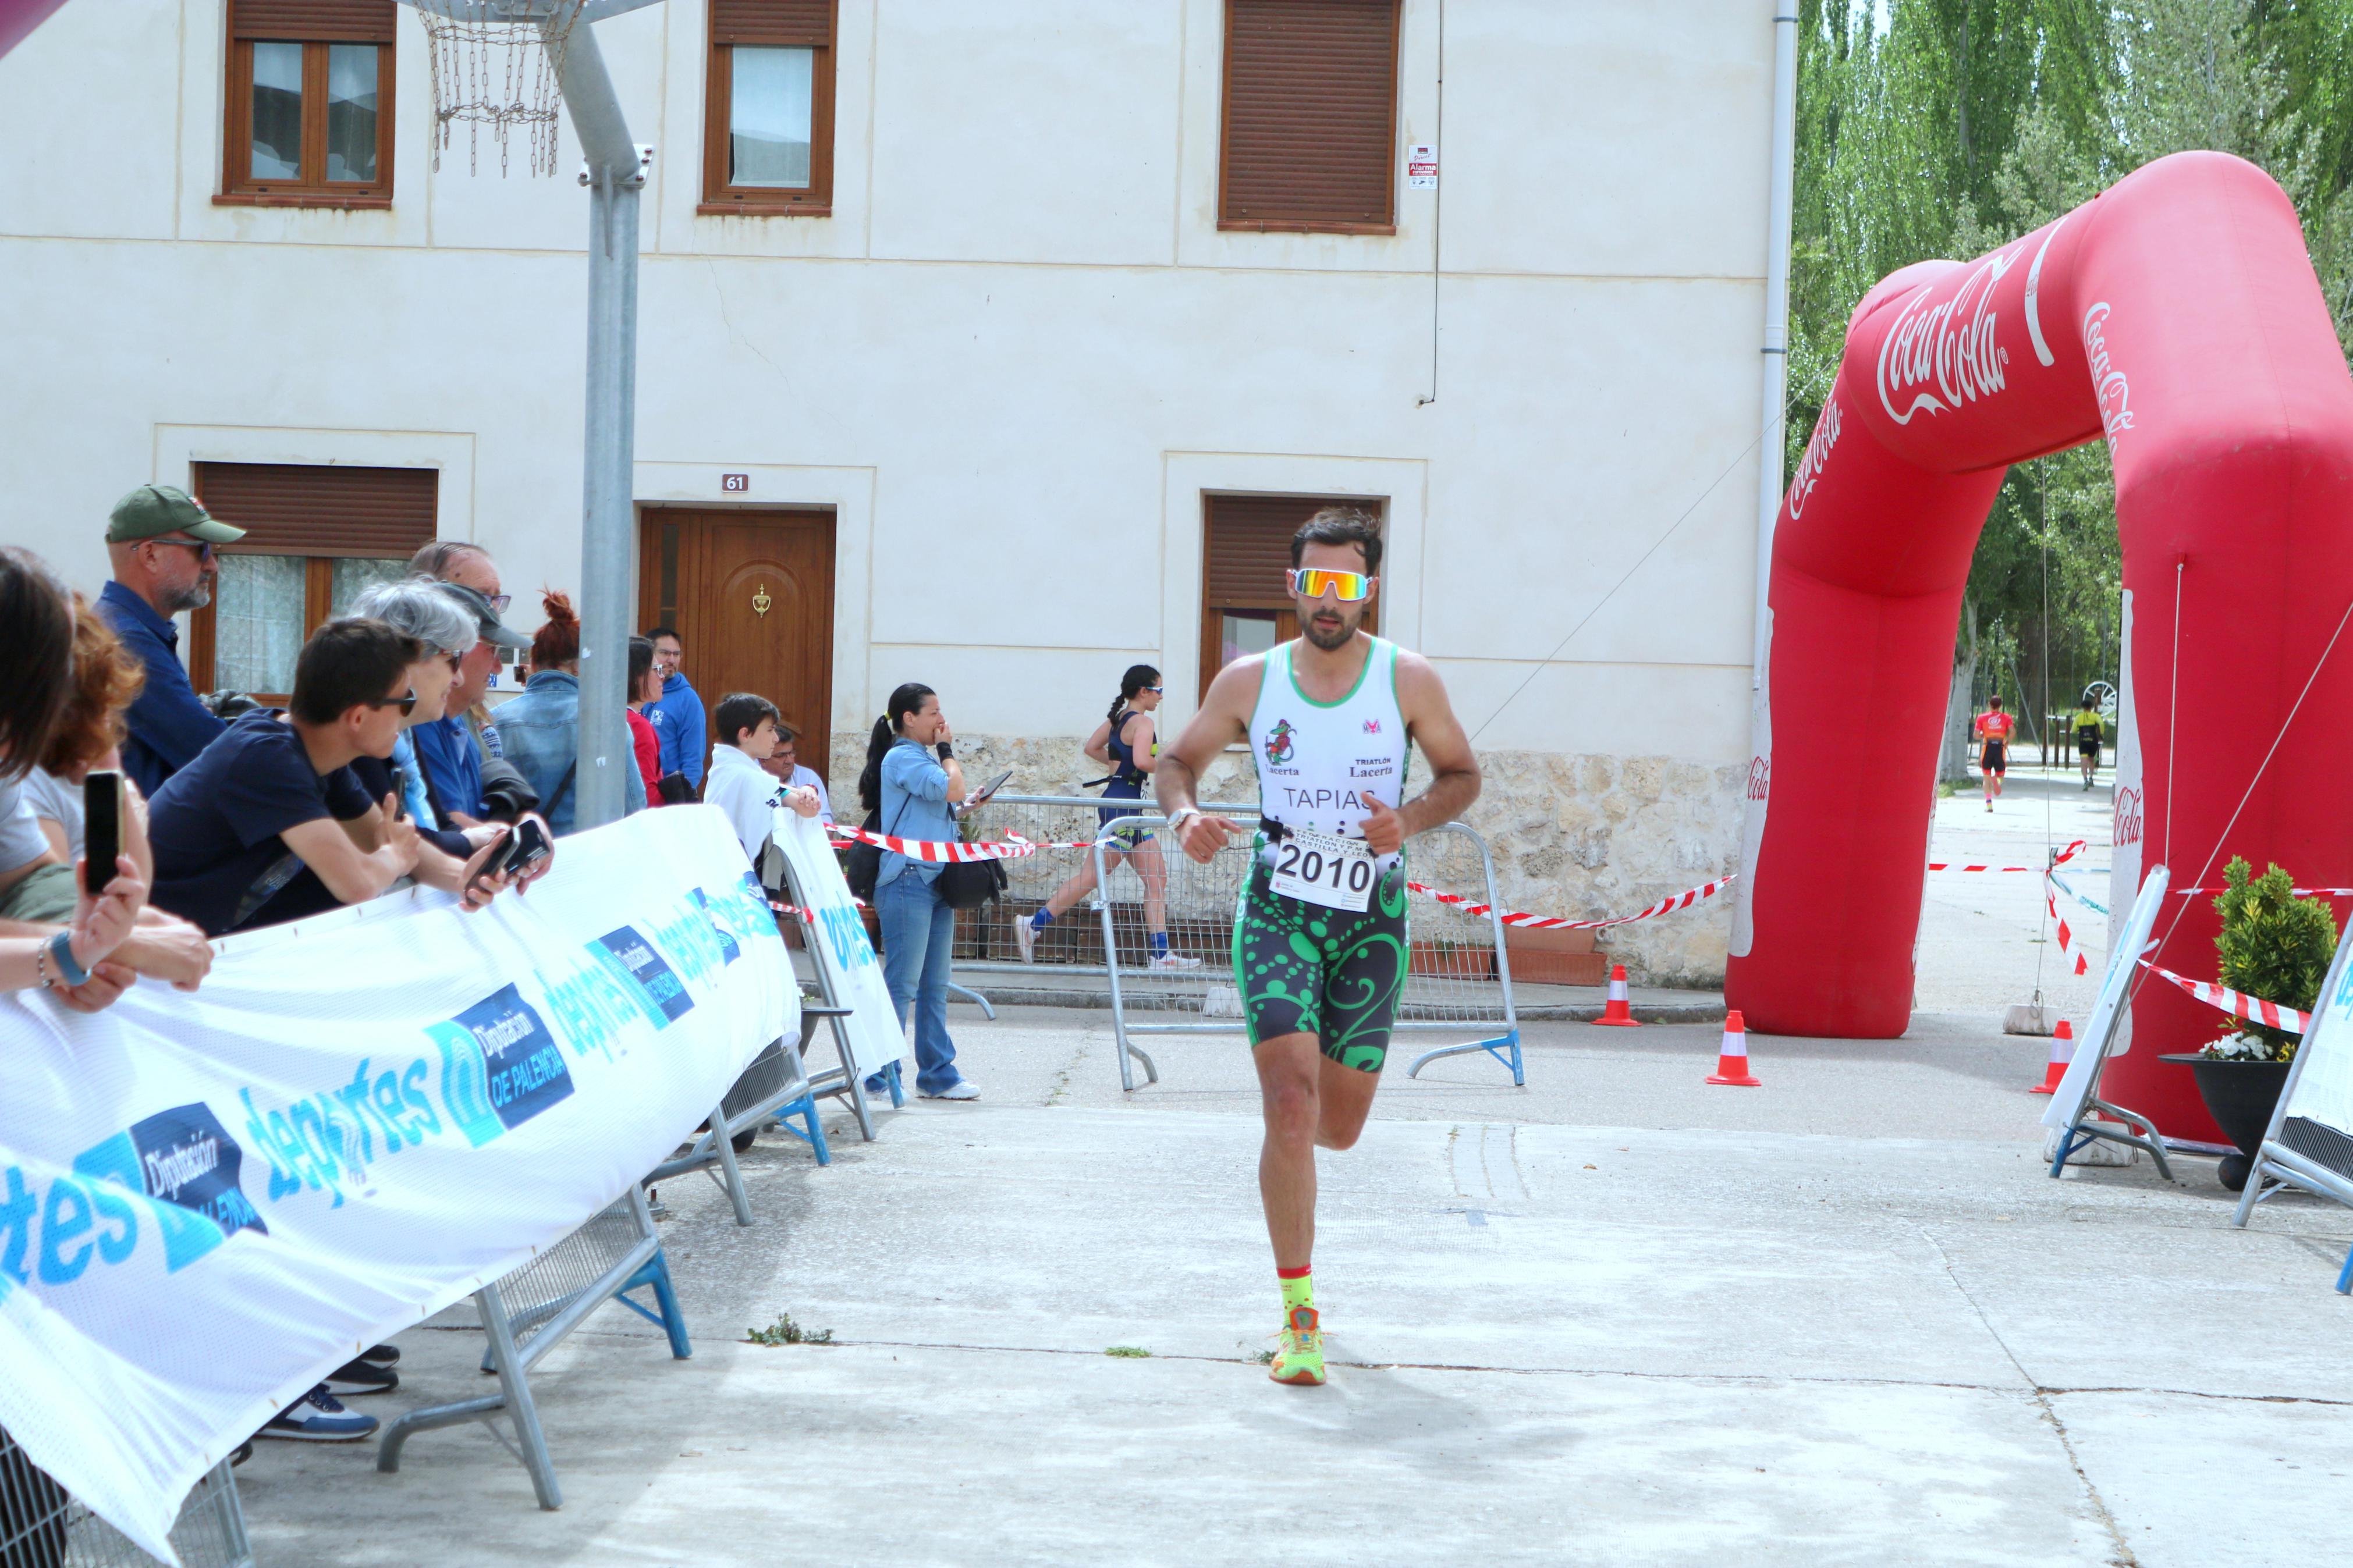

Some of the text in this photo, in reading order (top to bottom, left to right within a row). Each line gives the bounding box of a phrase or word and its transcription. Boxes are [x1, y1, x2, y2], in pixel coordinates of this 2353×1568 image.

[726, 477, 743, 490] 61
[1349, 766, 1393, 778] Lacerta
[1296, 838, 1339, 853] CASTILLA
[1276, 844, 1371, 893] 2010
[491, 1045, 566, 1108] DE PALENCIA
